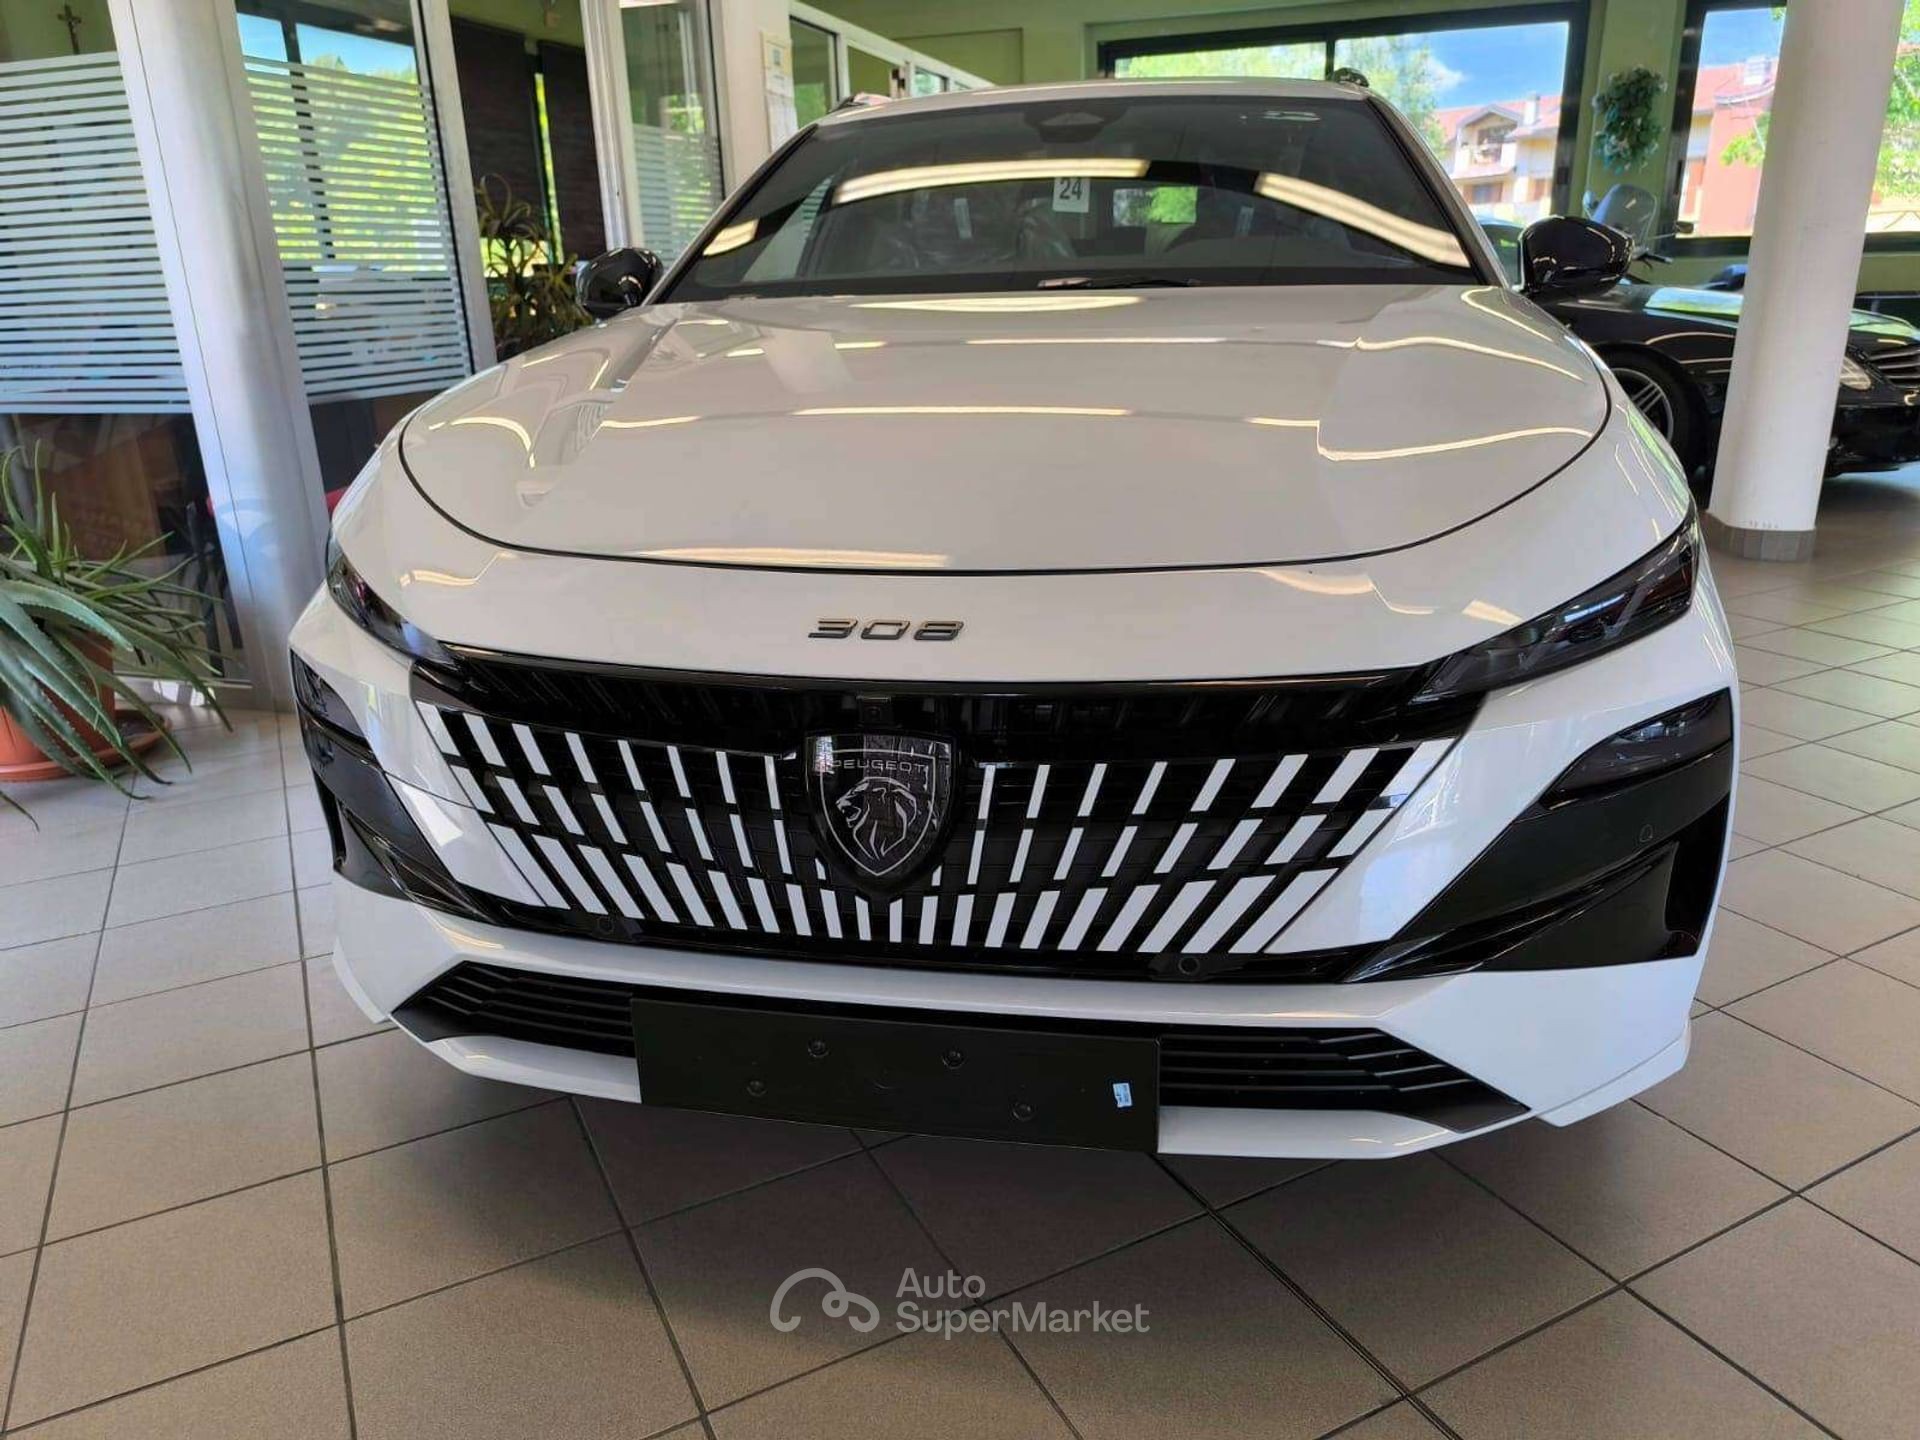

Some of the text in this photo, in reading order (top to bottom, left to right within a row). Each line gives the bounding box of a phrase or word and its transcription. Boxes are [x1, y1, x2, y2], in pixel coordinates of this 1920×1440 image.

[1059, 177, 1082, 200] 24
[808, 618, 964, 641] 308
[830, 758, 925, 773] PEUGEOT
